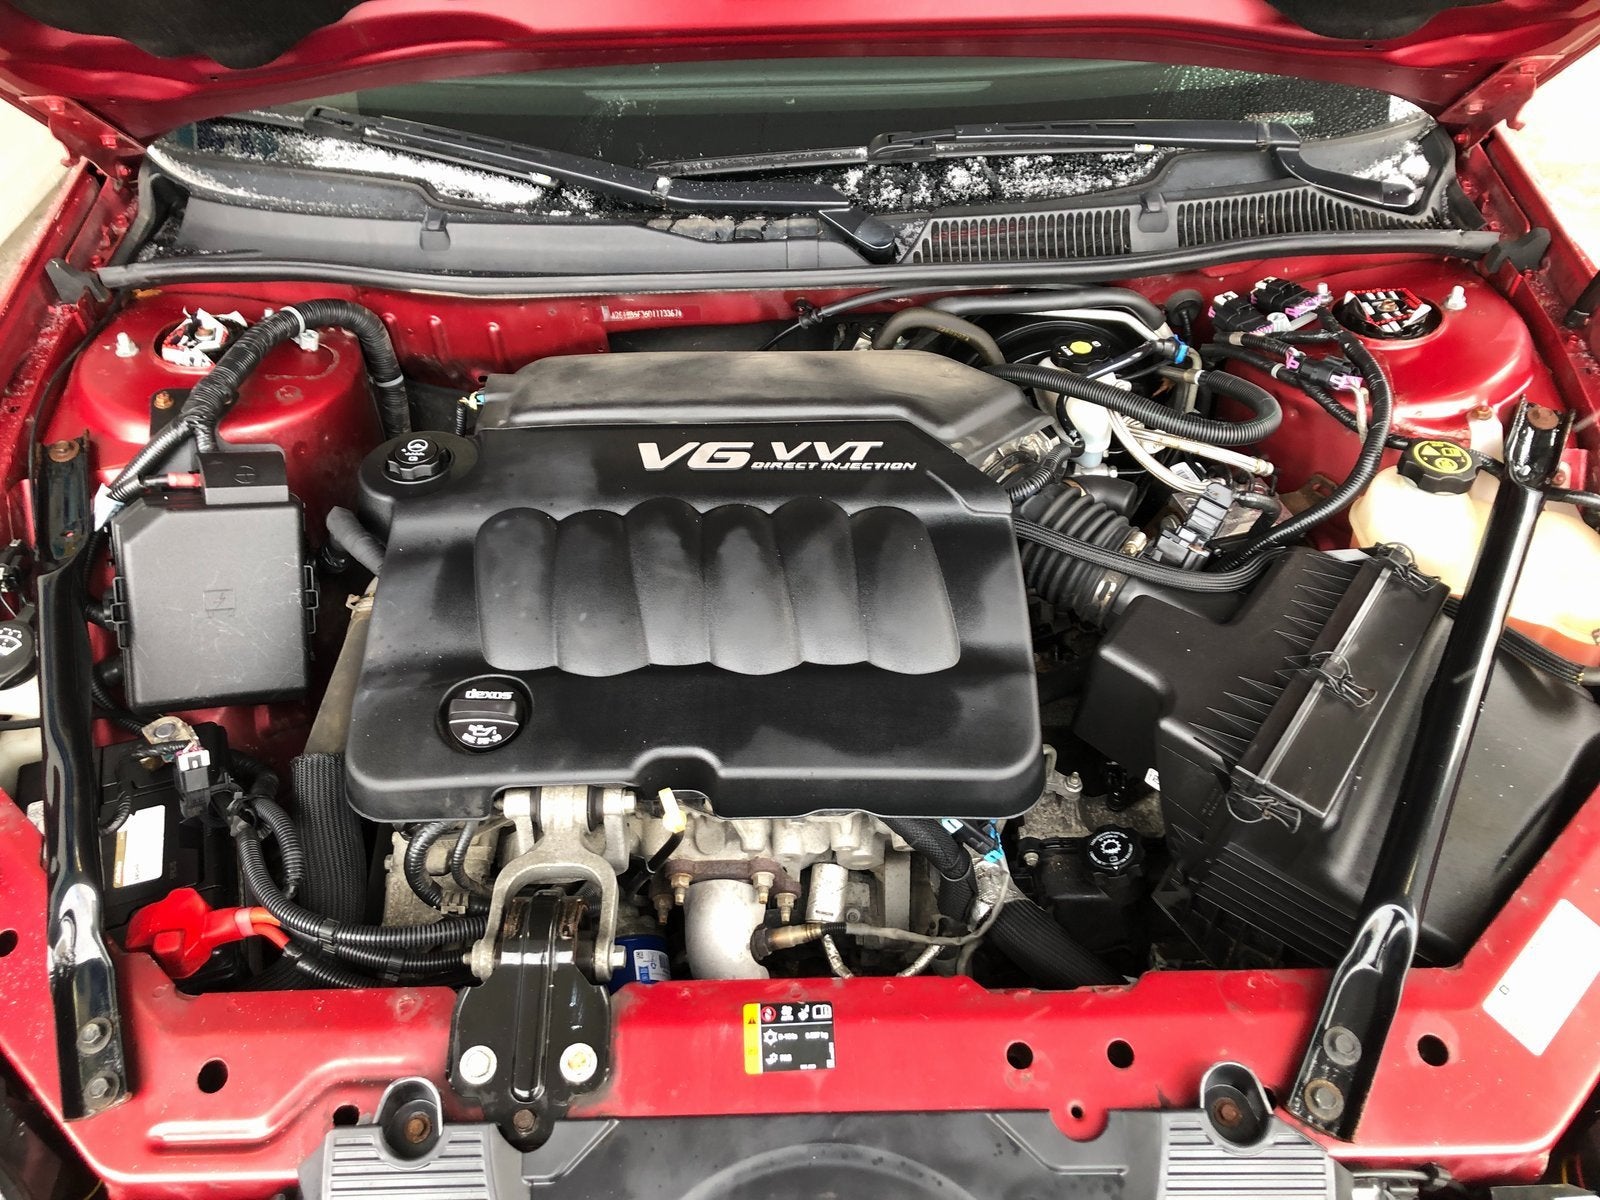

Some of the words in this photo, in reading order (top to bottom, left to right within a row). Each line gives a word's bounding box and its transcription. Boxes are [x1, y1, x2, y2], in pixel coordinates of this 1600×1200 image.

[637, 441, 754, 471] V6
[771, 441, 884, 461] VVT
[751, 461, 819, 471] DIRECT
[821, 461, 917, 471] INJECTION
[465, 688, 514, 700] dexos
